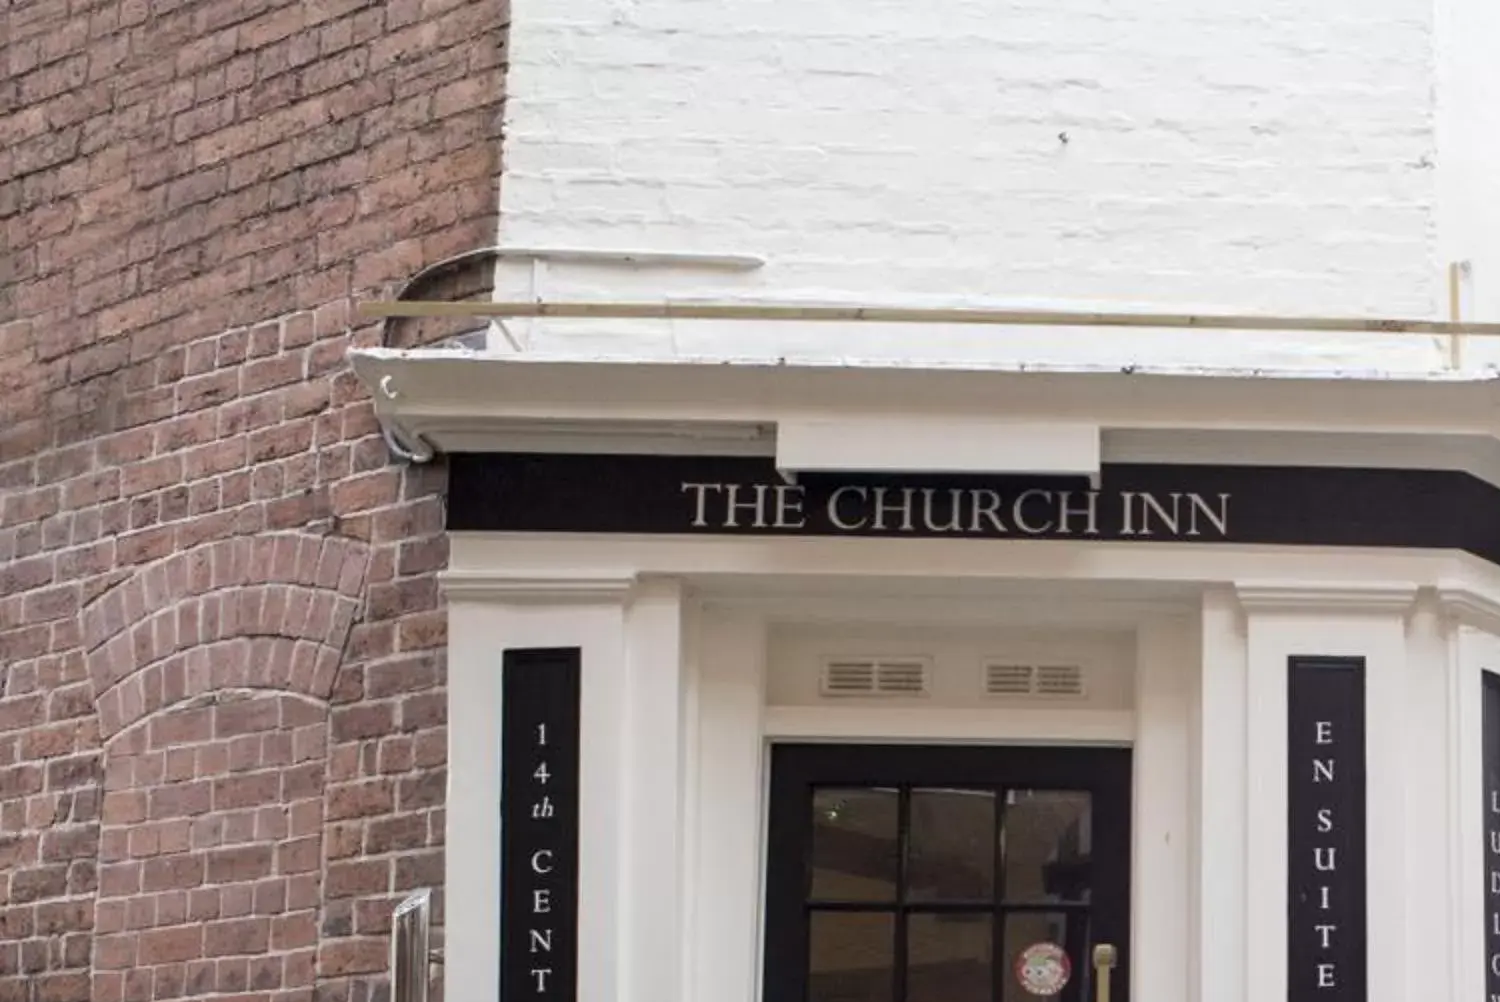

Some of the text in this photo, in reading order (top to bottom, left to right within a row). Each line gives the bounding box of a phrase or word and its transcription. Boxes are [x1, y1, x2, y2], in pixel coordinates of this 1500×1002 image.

[681, 481, 1231, 537] THE CHURCH INN
[1313, 721, 1335, 783] EN
[1313, 808, 1337, 989] SUITE
